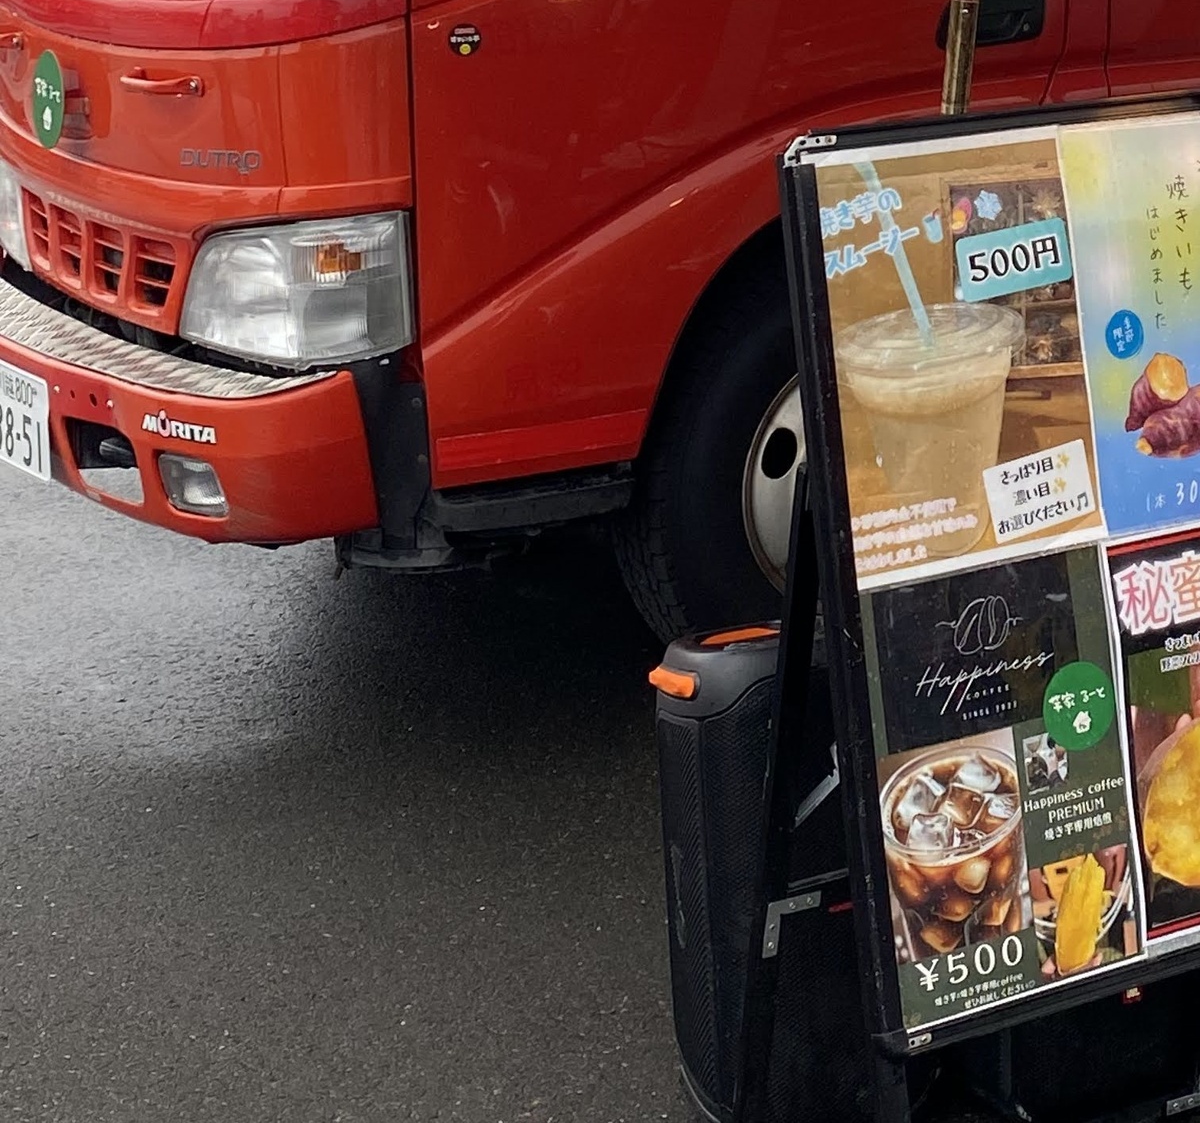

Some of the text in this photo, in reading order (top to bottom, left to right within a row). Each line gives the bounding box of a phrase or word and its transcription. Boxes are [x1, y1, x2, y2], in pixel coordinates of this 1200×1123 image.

[180, 148, 262, 175] DUTRO
[967, 235, 1061, 282] 500円
[1146, 206, 1168, 329] はじめました
[0, 406, 42, 473] 8-51
[141, 409, 217, 444] MORITA
[1000, 456, 1054, 486] さっぱり目
[1012, 481, 1051, 506] 濃い目
[998, 500, 1075, 535] お選びください
[915, 650, 1054, 715] Happiness
[965, 683, 1011, 701] COFFEE
[1023, 776, 1125, 813] Happiness coffee
[1048, 797, 1105, 823] PREMIUM
[915, 935, 1024, 992] ¥500
